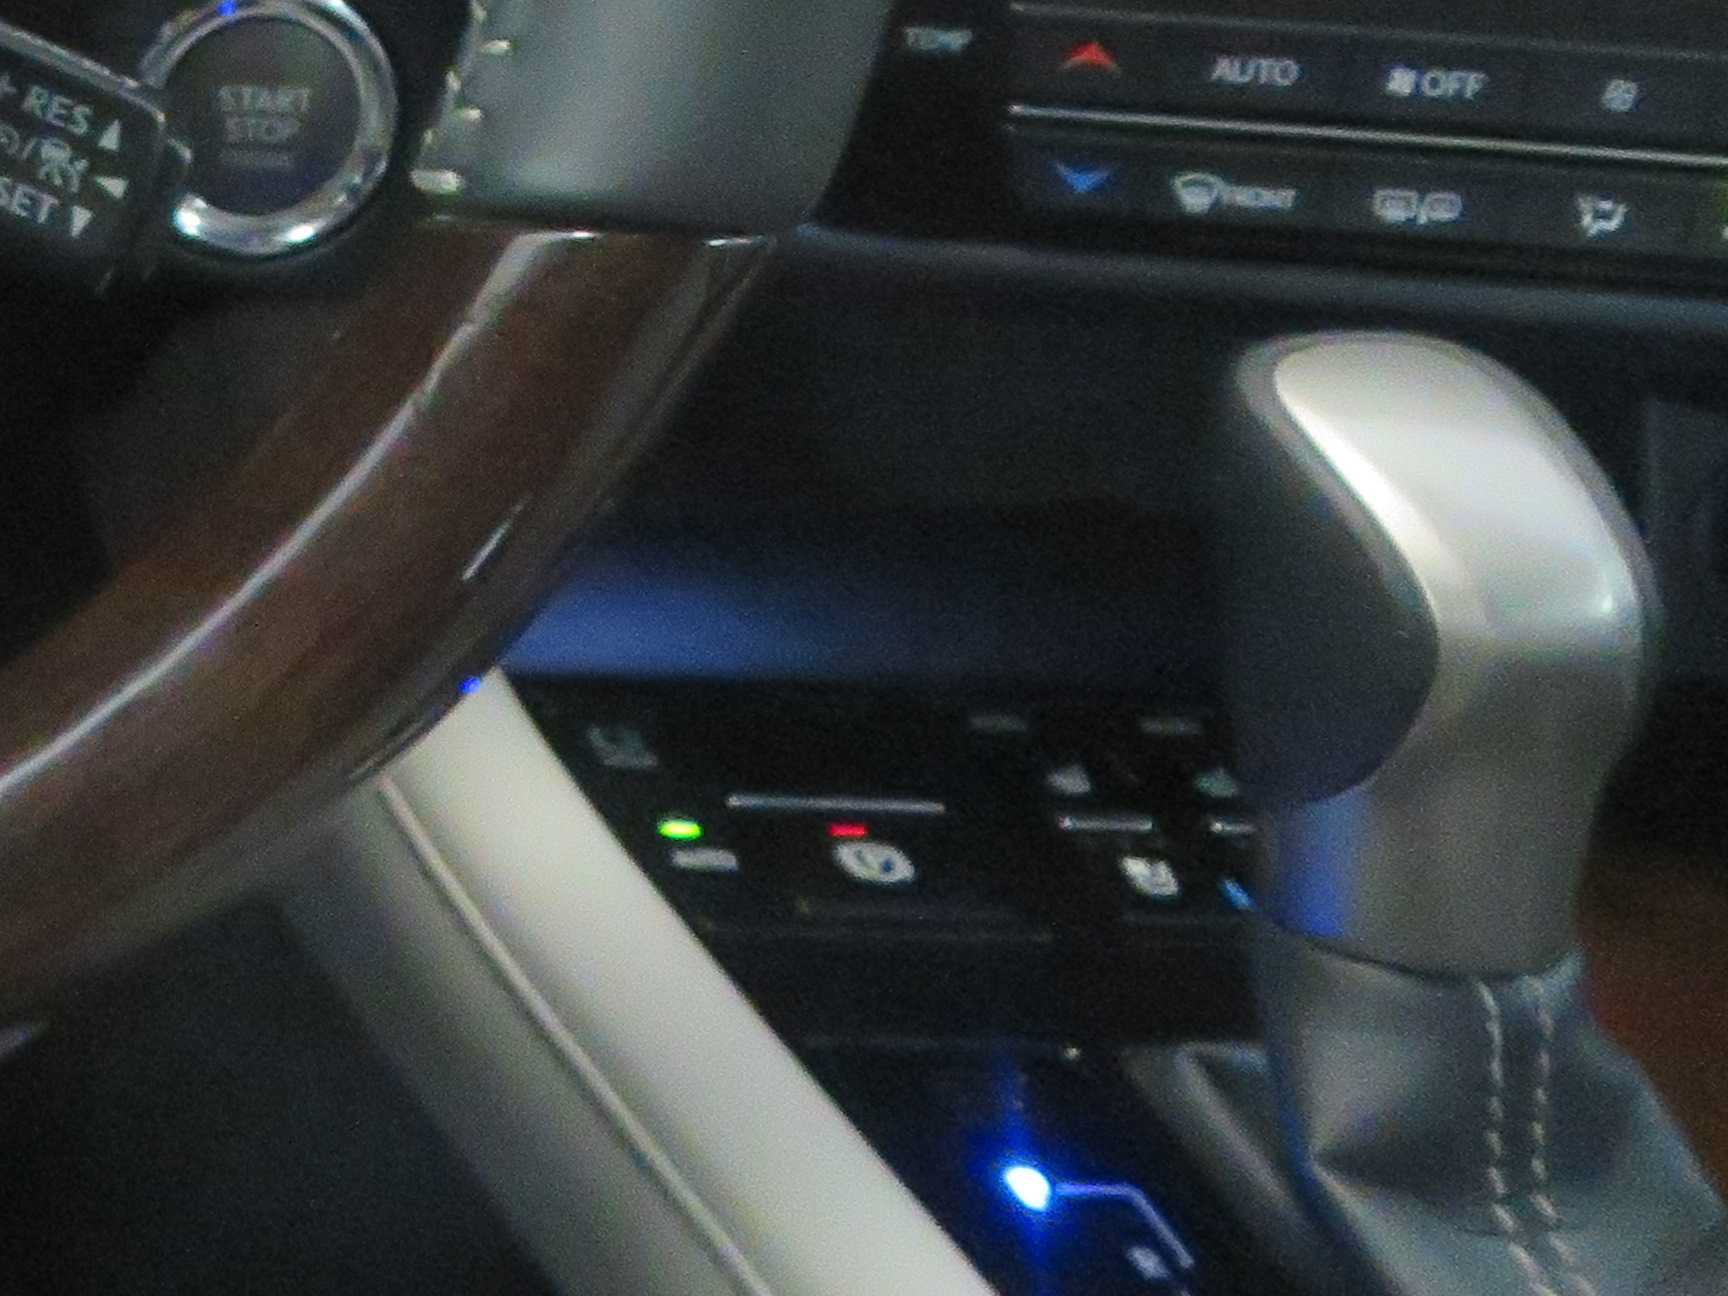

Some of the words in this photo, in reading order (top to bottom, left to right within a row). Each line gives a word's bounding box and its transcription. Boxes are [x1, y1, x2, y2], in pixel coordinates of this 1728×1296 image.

[1210, 53, 1302, 89] AUTO
[1419, 67, 1489, 101] OFF
[21, 83, 94, 137] RES
[217, 84, 313, 113] START
